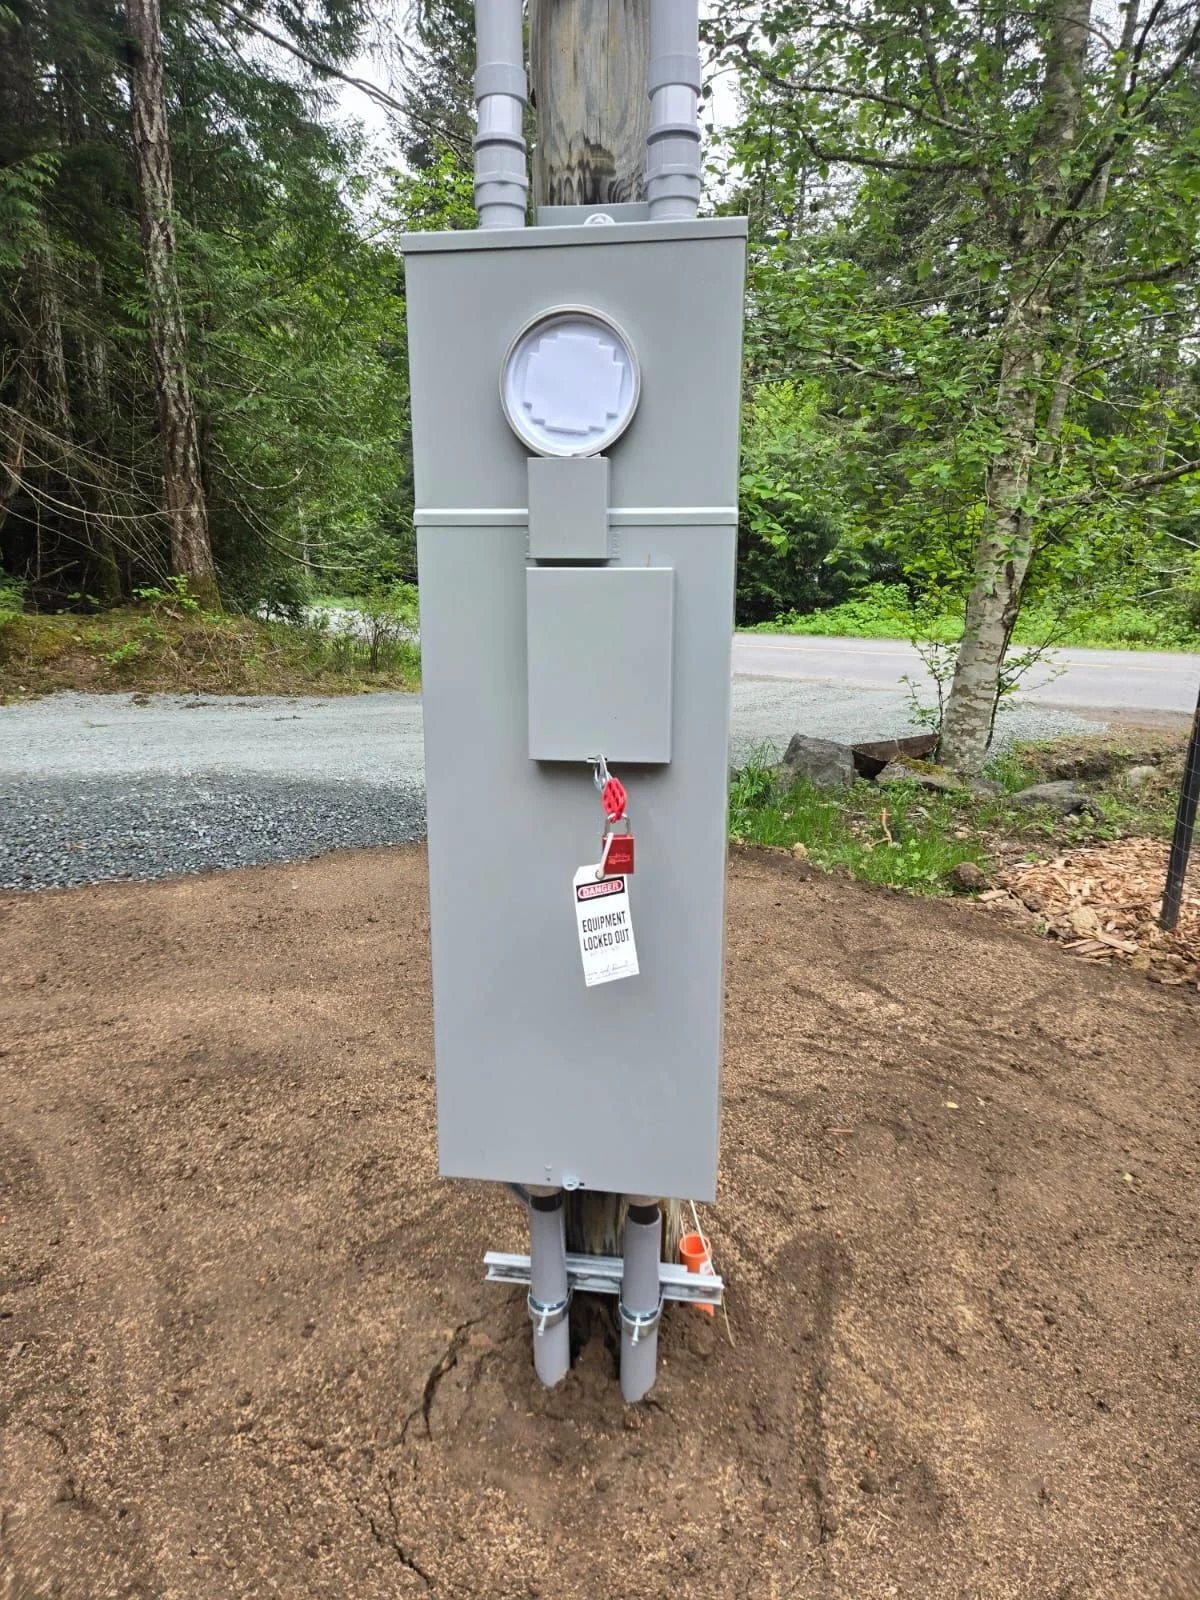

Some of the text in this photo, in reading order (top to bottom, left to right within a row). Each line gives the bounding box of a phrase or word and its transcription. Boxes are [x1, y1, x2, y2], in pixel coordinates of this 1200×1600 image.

[582, 881, 619, 897] DANGER
[582, 910, 626, 933] EQUIPMENT
[583, 932, 613, 952] LOCKED
[614, 928, 630, 944] OUT
